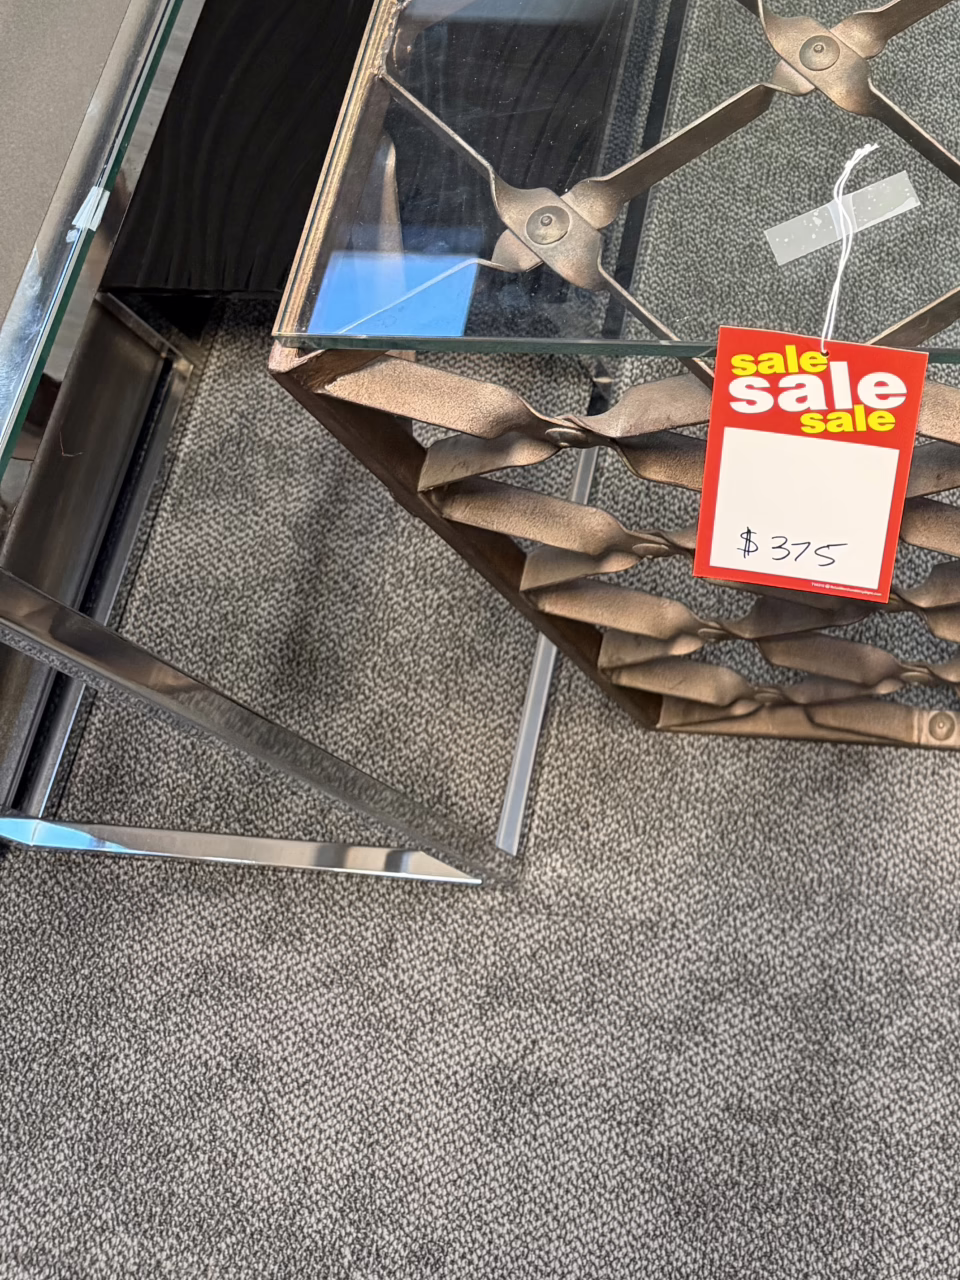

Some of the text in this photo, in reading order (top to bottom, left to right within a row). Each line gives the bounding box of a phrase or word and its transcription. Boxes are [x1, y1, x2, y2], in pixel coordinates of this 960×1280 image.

[730, 345, 828, 376] sale
[728, 361, 907, 413] sale
[800, 404, 896, 434] sale
